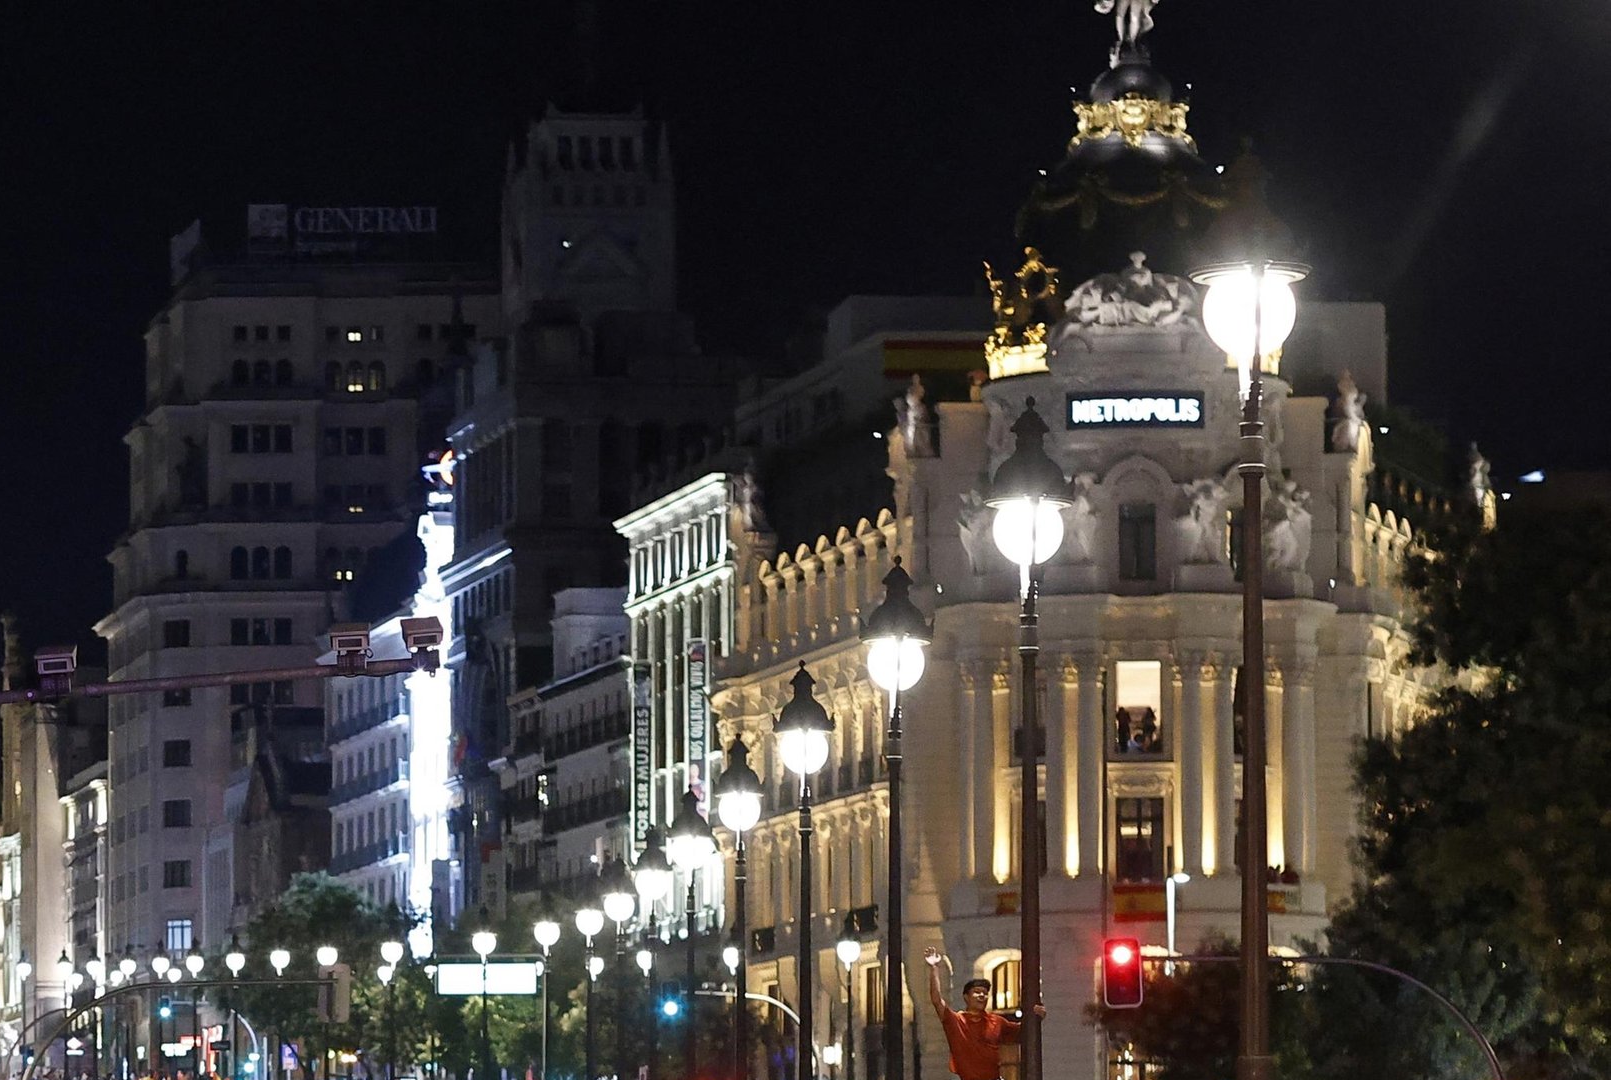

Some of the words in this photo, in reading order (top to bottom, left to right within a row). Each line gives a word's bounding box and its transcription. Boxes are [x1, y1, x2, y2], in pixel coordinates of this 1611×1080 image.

[294, 206, 438, 233] GENERALI
[1072, 398, 1201, 424] METROPOLIS
[636, 707, 649, 781] MUJERES
[636, 782, 649, 808] SER
[636, 809, 649, 840] POR
